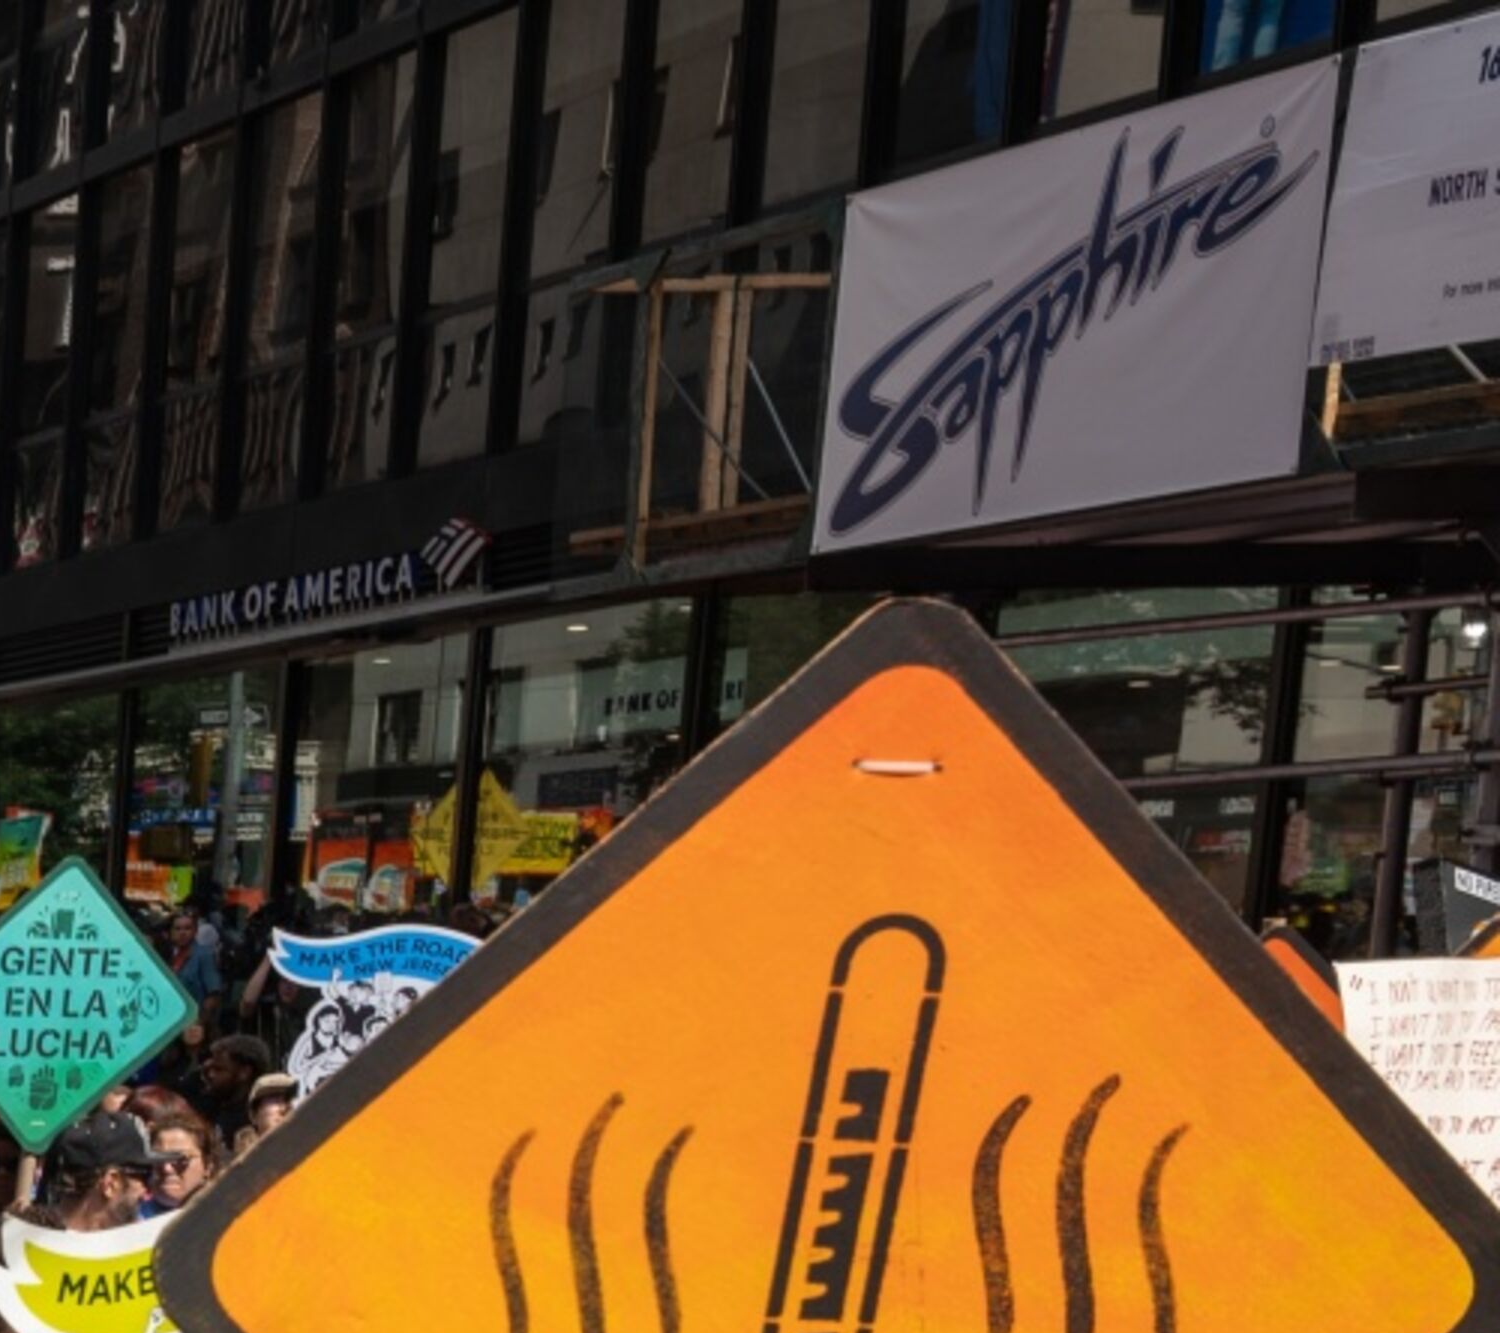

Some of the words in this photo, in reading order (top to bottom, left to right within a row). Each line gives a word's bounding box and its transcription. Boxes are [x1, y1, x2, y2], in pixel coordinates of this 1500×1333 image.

[1428, 168, 1488, 208] NORTH
[830, 110, 1320, 538] Sapphire
[169, 590, 235, 637] BANK
[243, 581, 278, 622] OF
[282, 553, 413, 613] AMERICA
[0, 946, 121, 977] GENTE
[300, 948, 361, 967] MAKE
[367, 940, 406, 956] THE
[354, 960, 394, 975] NEW
[5, 988, 50, 1018] EN
[62, 988, 107, 1018] LA
[56, 1266, 158, 1308] MAKE
